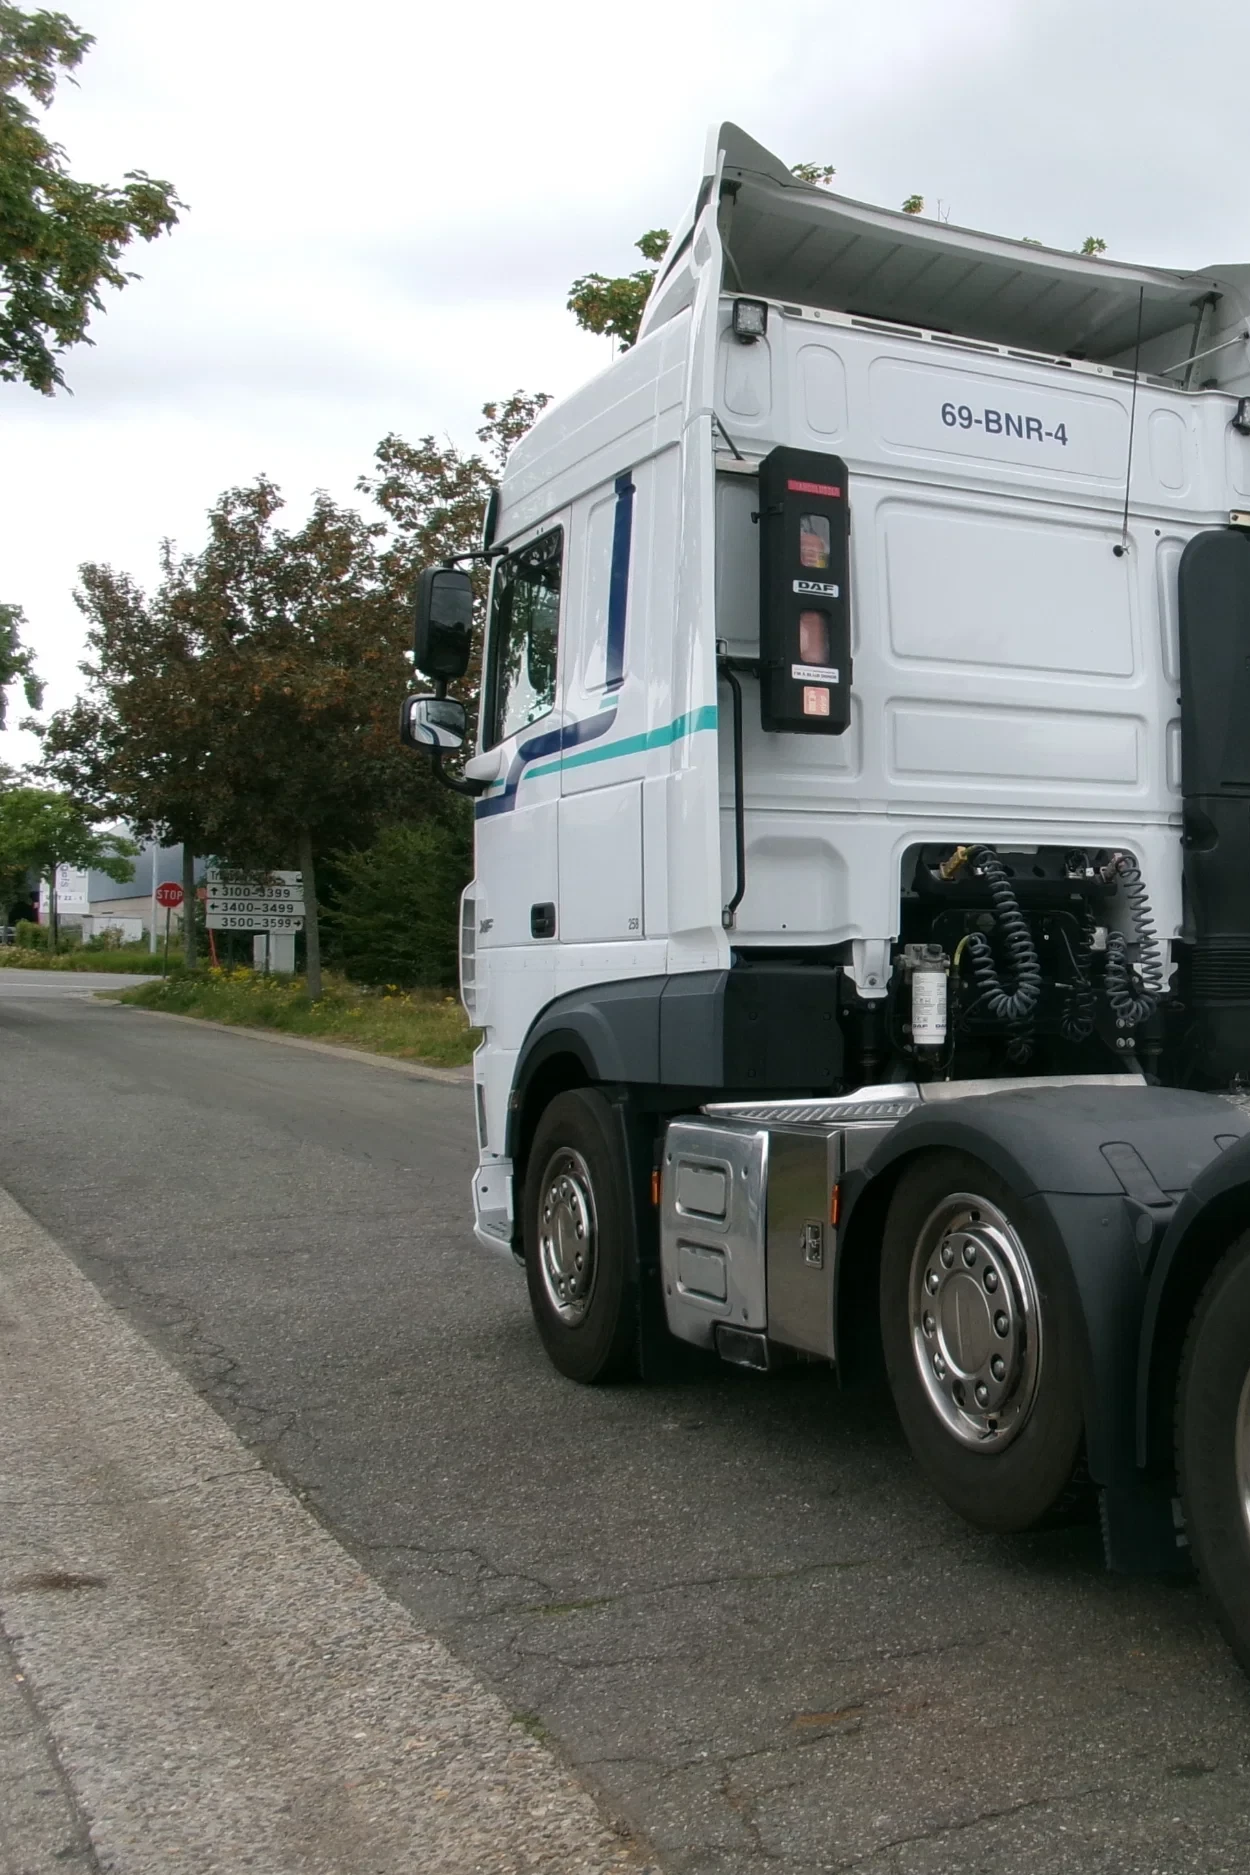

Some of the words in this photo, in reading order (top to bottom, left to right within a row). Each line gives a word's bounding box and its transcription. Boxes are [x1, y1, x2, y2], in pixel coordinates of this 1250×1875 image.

[941, 402, 1069, 446] 69-BNR-4
[798, 582, 834, 592] DAF
[157, 890, 183, 899] STOP
[221, 886, 291, 898] 3100-3399
[221, 902, 294, 914] 3400-3499
[221, 917, 291, 928] 3500-3599
[479, 918, 494, 933] XF
[628, 918, 639, 930] 258
